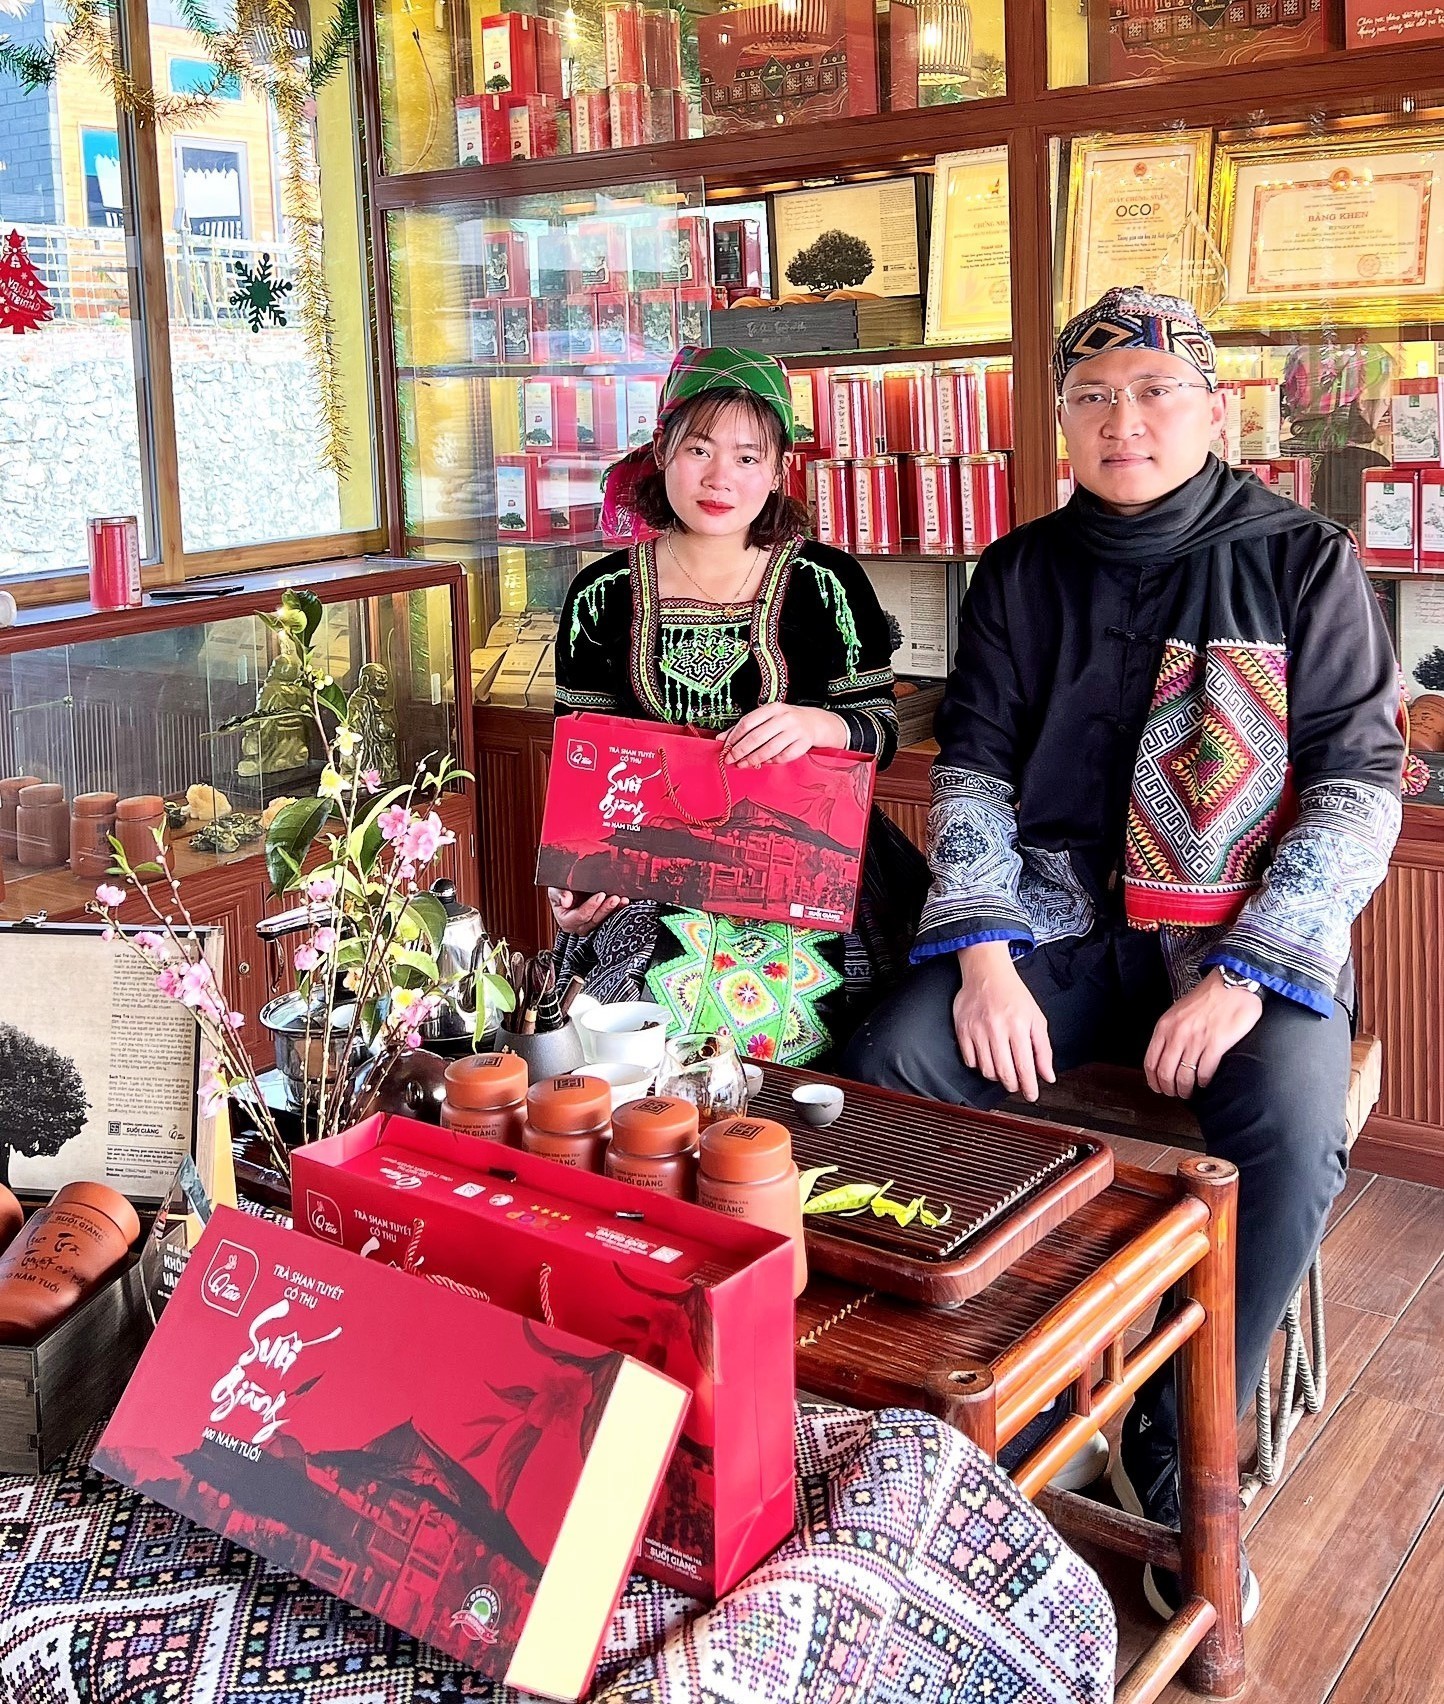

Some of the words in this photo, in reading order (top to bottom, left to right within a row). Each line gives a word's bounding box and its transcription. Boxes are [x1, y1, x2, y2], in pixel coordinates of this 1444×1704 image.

[1116, 203, 1161, 217] OCOP
[1339, 211, 1369, 221] KHEN
[636, 1177, 664, 1188] GIÀNG
[717, 1202, 745, 1214] GIÀNG
[354, 1209, 368, 1222] TRÀ
[369, 1215, 389, 1230] SHAN
[273, 1264, 291, 1281] TRÀ
[289, 1271, 317, 1290] SHAN
[315, 1280, 345, 1301] TUYẾT
[214, 1430, 241, 1451] NĂM
[650, 1546, 670, 1562] SUỐI
[670, 1555, 698, 1575] GIÀNG
[470, 1588, 498, 1614] ORGANIC
